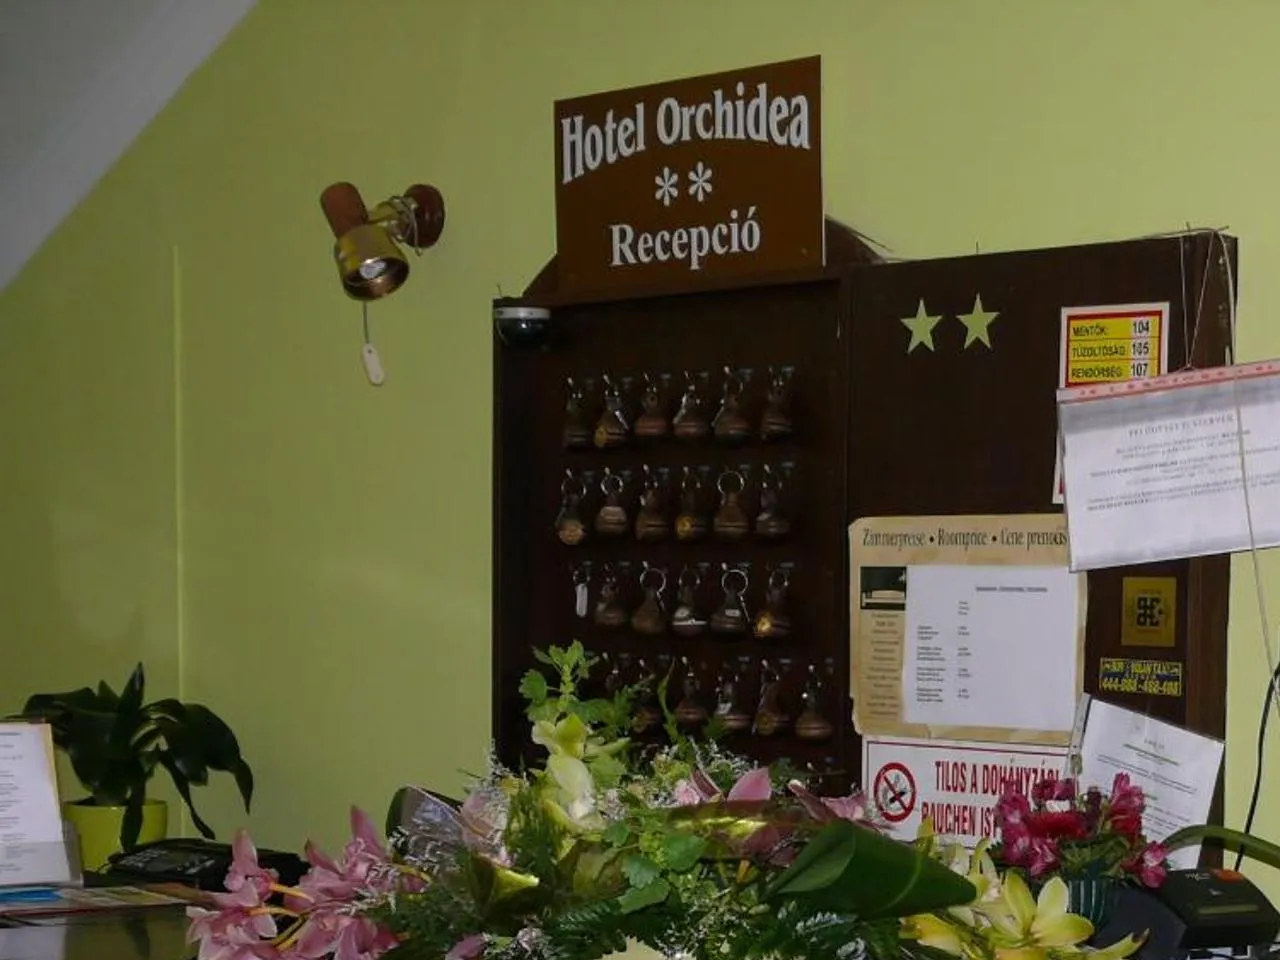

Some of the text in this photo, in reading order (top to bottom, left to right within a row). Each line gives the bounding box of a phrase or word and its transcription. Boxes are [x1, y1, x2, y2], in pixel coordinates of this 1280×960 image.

[561, 81, 811, 185] Hotel Orchidea
[609, 206, 761, 271] Recepció
[1132, 319, 1151, 335] 104
[1131, 362, 1149, 378] 107
[862, 528, 926, 551] Zimmerpreise
[937, 528, 988, 550] Roomprice
[935, 761, 967, 792] TILOS
[970, 766, 978, 794] A
